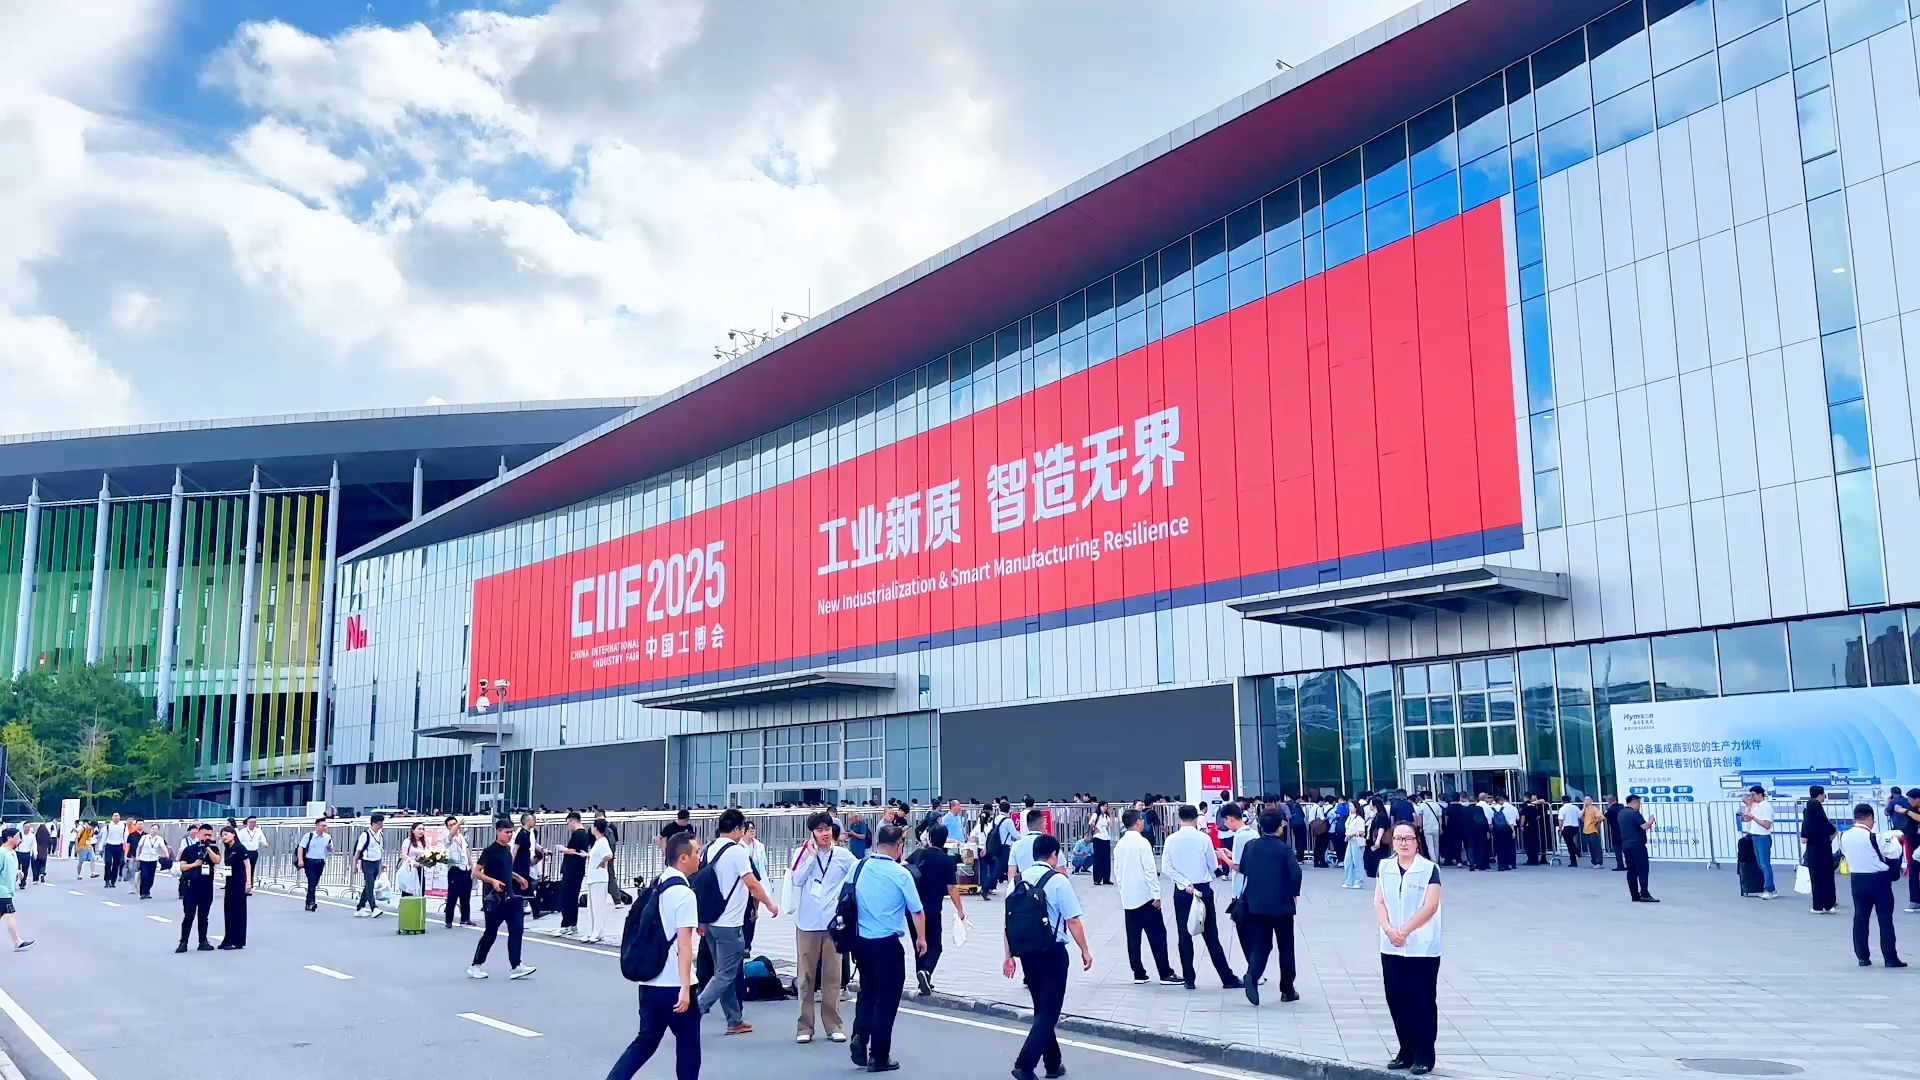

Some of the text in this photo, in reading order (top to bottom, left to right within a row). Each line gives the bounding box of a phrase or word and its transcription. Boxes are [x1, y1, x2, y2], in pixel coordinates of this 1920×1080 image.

[818, 405, 1185, 576] 工业新质 智造无界
[818, 516, 1189, 616] New Industrialization & Smart Manufacturing Resilience
[571, 540, 725, 639] CIIF 2025
[571, 639, 640, 661] CHINA INTERNATIONAL
[645, 622, 725, 660] 中国工博会
[592, 651, 640, 669] INDUSTRY FAIR
[1626, 739, 1762, 755] 从设备集成商到您的生产力伙伴
[1627, 756, 1742, 770] 从工具提供者到价值共创者
